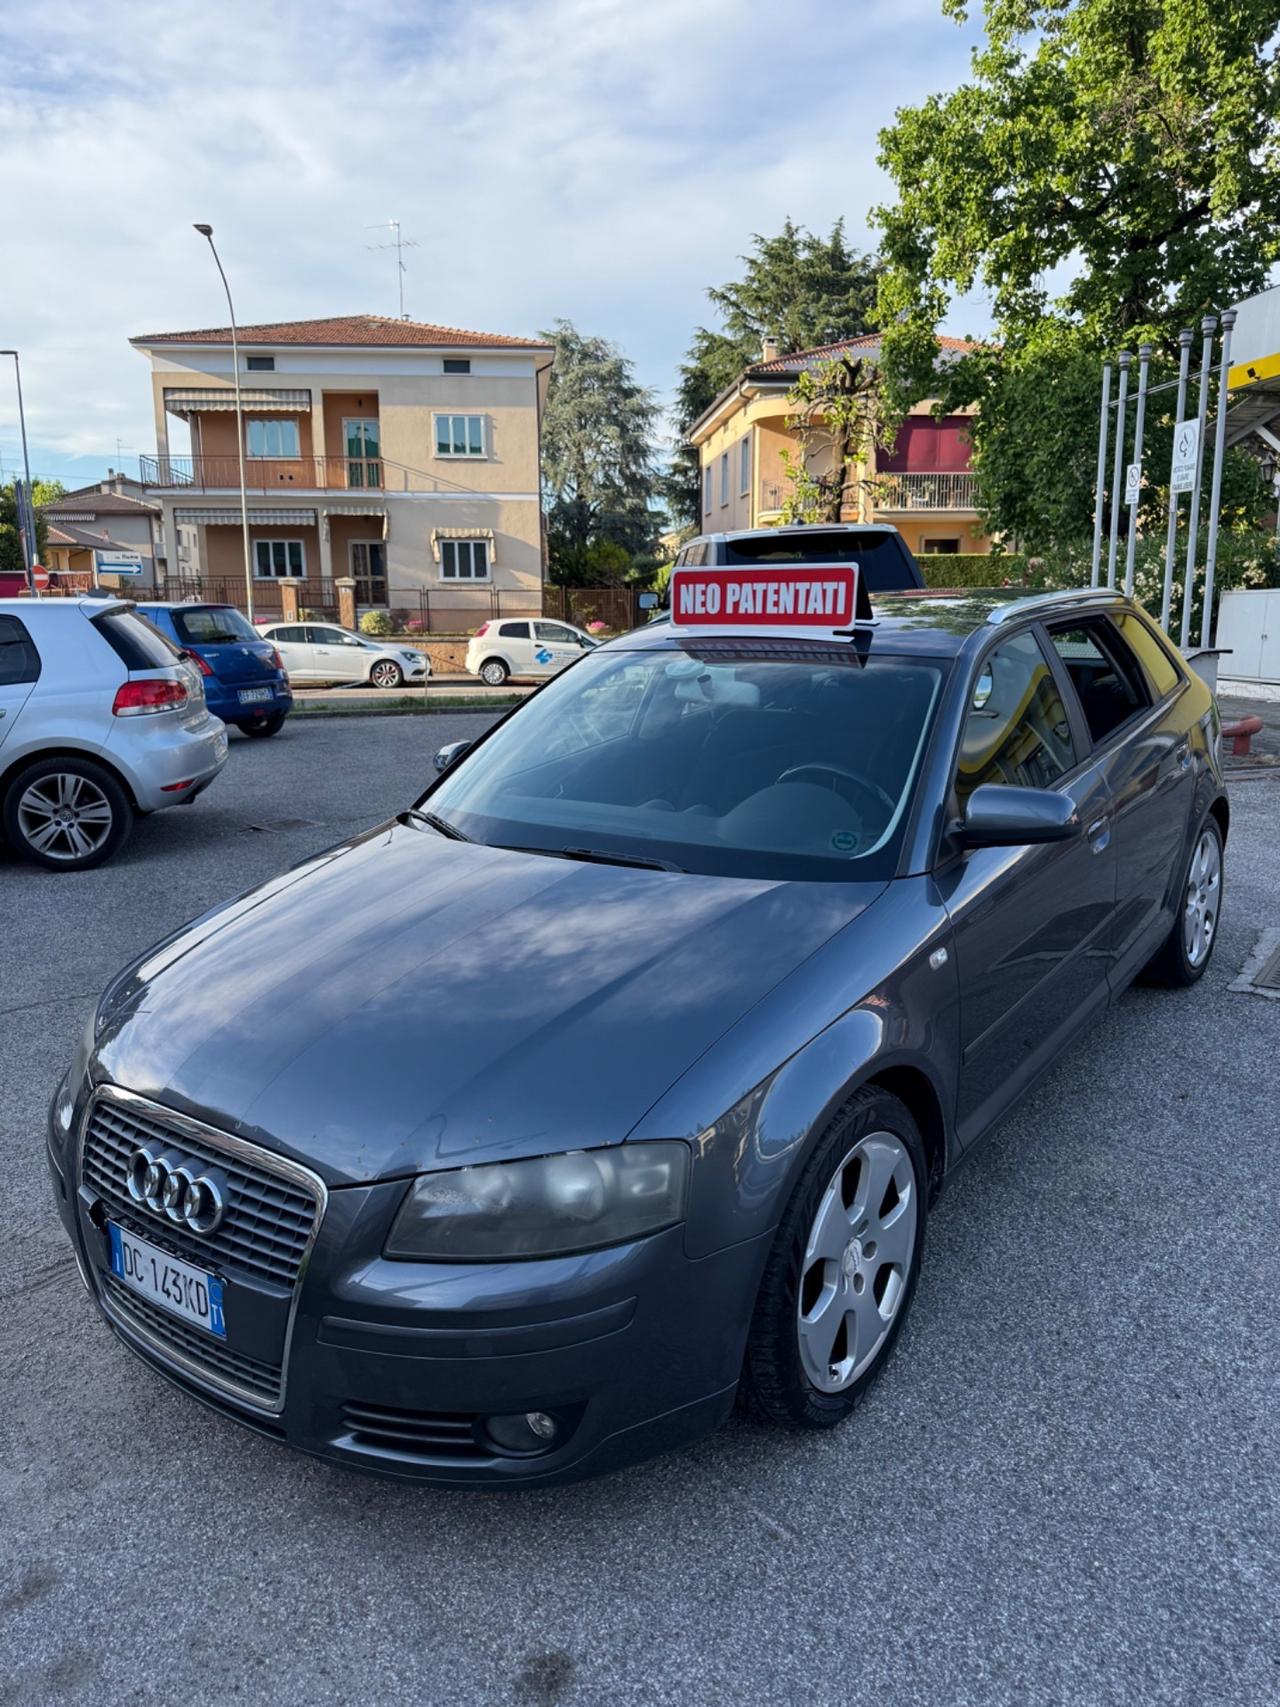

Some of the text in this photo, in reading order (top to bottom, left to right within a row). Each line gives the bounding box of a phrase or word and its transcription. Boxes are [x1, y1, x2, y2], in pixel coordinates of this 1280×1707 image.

[680, 581, 847, 615] NEO PATENTATI
[122, 1241, 209, 1318] DC 143KD
